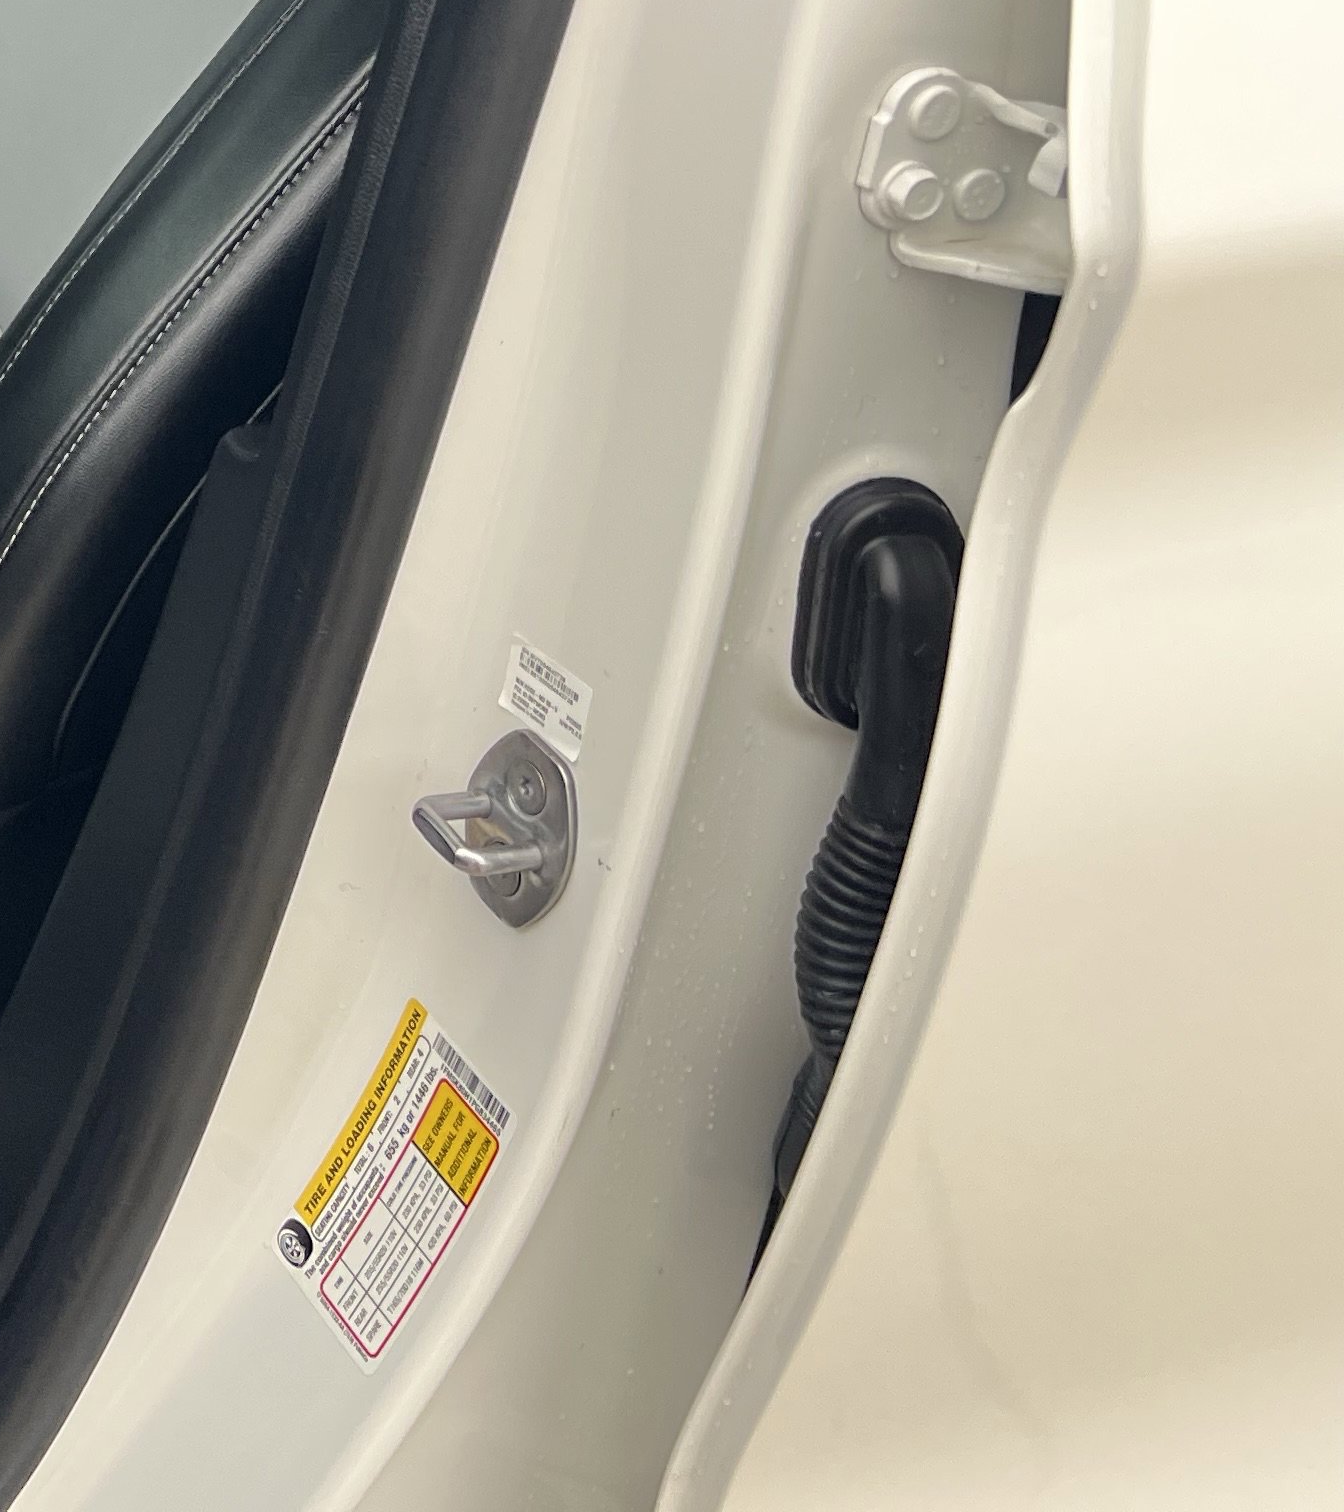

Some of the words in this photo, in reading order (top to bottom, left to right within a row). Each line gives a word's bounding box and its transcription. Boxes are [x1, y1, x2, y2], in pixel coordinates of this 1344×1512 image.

[416, 1047, 424, 1058] 4
[303, 1182, 326, 1217] TIRE
[323, 1153, 344, 1186] AND
[340, 1097, 377, 1157] LOADING
[373, 1007, 421, 1099] INFORMATION
[383, 1136, 399, 1161] 655
[396, 1120, 410, 1139] kg
[405, 1109, 415, 1124] or
[424, 1063, 438, 1085] lbs.
[392, 1094, 400, 1105] 2
[421, 1133, 435, 1154] SEE
[430, 1097, 454, 1137] OWNERS
[433, 1129, 456, 1168] MANUAL
[451, 1110, 466, 1131] FOR
[446, 1126, 477, 1181] ADDITIONAL
[456, 1135, 492, 1198] INFORMATION
[315, 1209, 333, 1237] SEATING
[330, 1181, 350, 1213] CAPACITY
[304, 1262, 316, 1280] The
